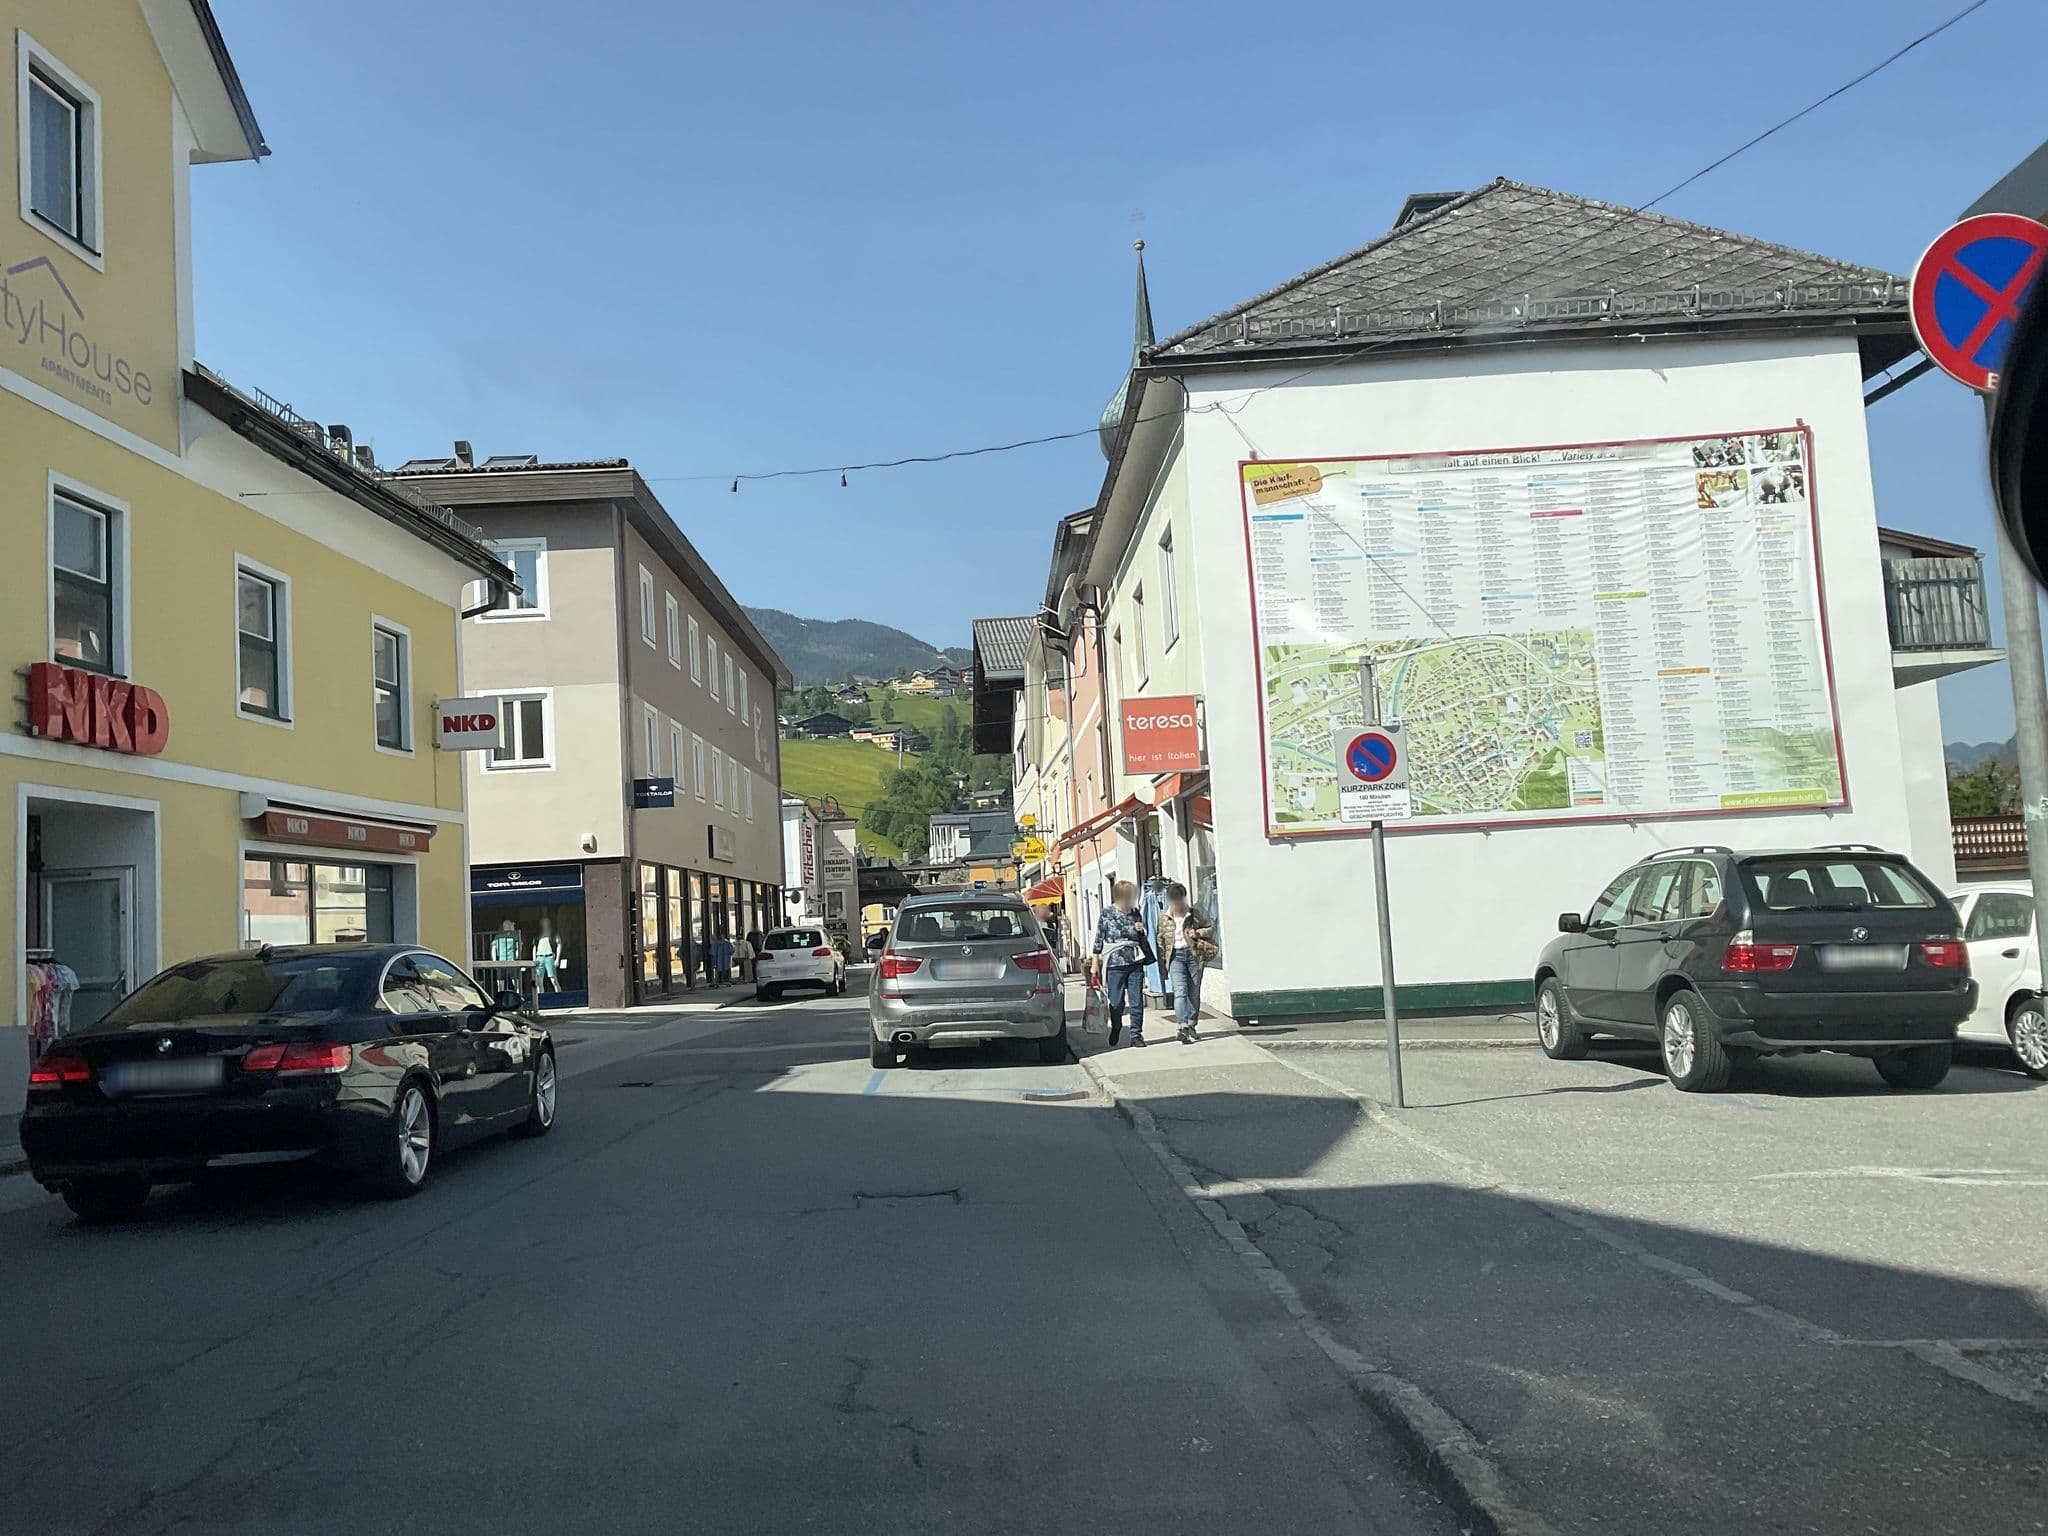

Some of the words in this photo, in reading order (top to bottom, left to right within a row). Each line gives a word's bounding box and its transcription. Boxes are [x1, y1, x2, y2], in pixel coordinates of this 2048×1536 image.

[1463, 457, 1479, 468] auf
[1481, 455, 1509, 467] einen
[1512, 454, 1541, 465] Blick!
[1253, 479, 1269, 488] Die
[31, 662, 169, 756] NKD
[442, 713, 497, 734] NKD
[1126, 714, 1194, 731] teresa
[1128, 753, 1147, 762] hier
[1151, 752, 1163, 761] ist
[1167, 751, 1197, 761] Italien
[1341, 782, 1407, 792] KURZPARKZONE
[287, 818, 308, 834] NKD
[347, 826, 367, 841] NKD
